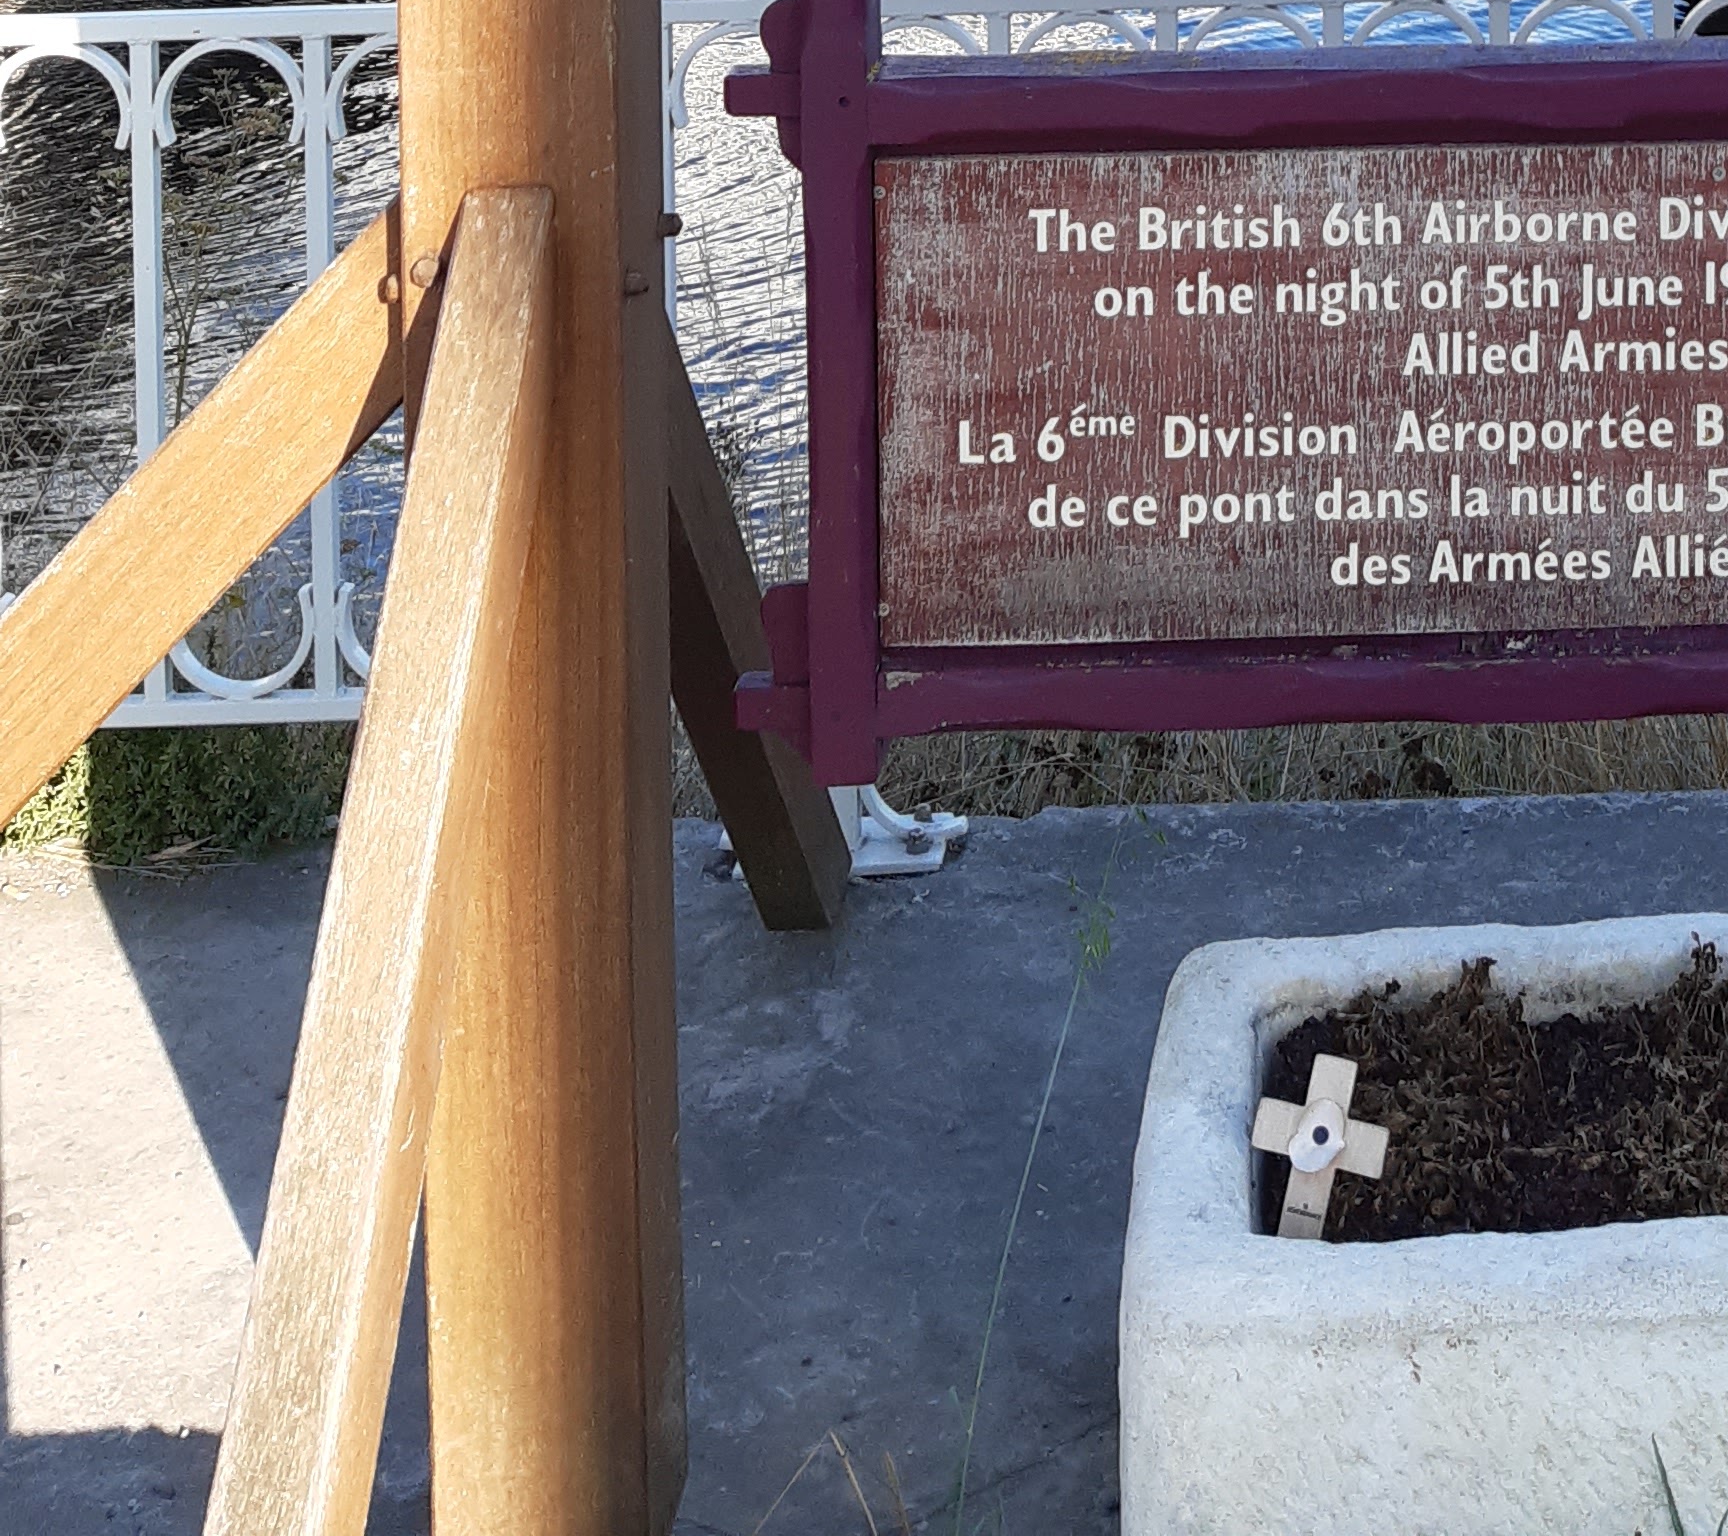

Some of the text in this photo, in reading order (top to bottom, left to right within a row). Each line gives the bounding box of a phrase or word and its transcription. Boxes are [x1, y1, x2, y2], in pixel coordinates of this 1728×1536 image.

[1027, 207, 1117, 254] The
[1138, 203, 1301, 251] British
[1321, 201, 1403, 248] 6th
[1421, 198, 1638, 245] Airborne
[1093, 285, 1155, 318] on
[1175, 270, 1255, 317] the
[1275, 267, 1402, 328] night
[1419, 264, 1469, 311] of
[1483, 263, 1560, 310] 5th
[1576, 262, 1684, 322] June
[1401, 329, 1540, 377] Allied
[958, 419, 1018, 465] La
[1163, 411, 1358, 460] Division
[1392, 404, 1675, 466] Aéroportée
[1027, 483, 1087, 529] de
[1106, 494, 1159, 527] ce
[1178, 484, 1296, 540] pont
[1313, 476, 1429, 522] dans
[1449, 473, 1491, 519] la
[1510, 469, 1608, 517] nuit
[1624, 469, 1685, 515] du
[1329, 541, 1412, 587] des
[1428, 537, 1612, 584] Armées
